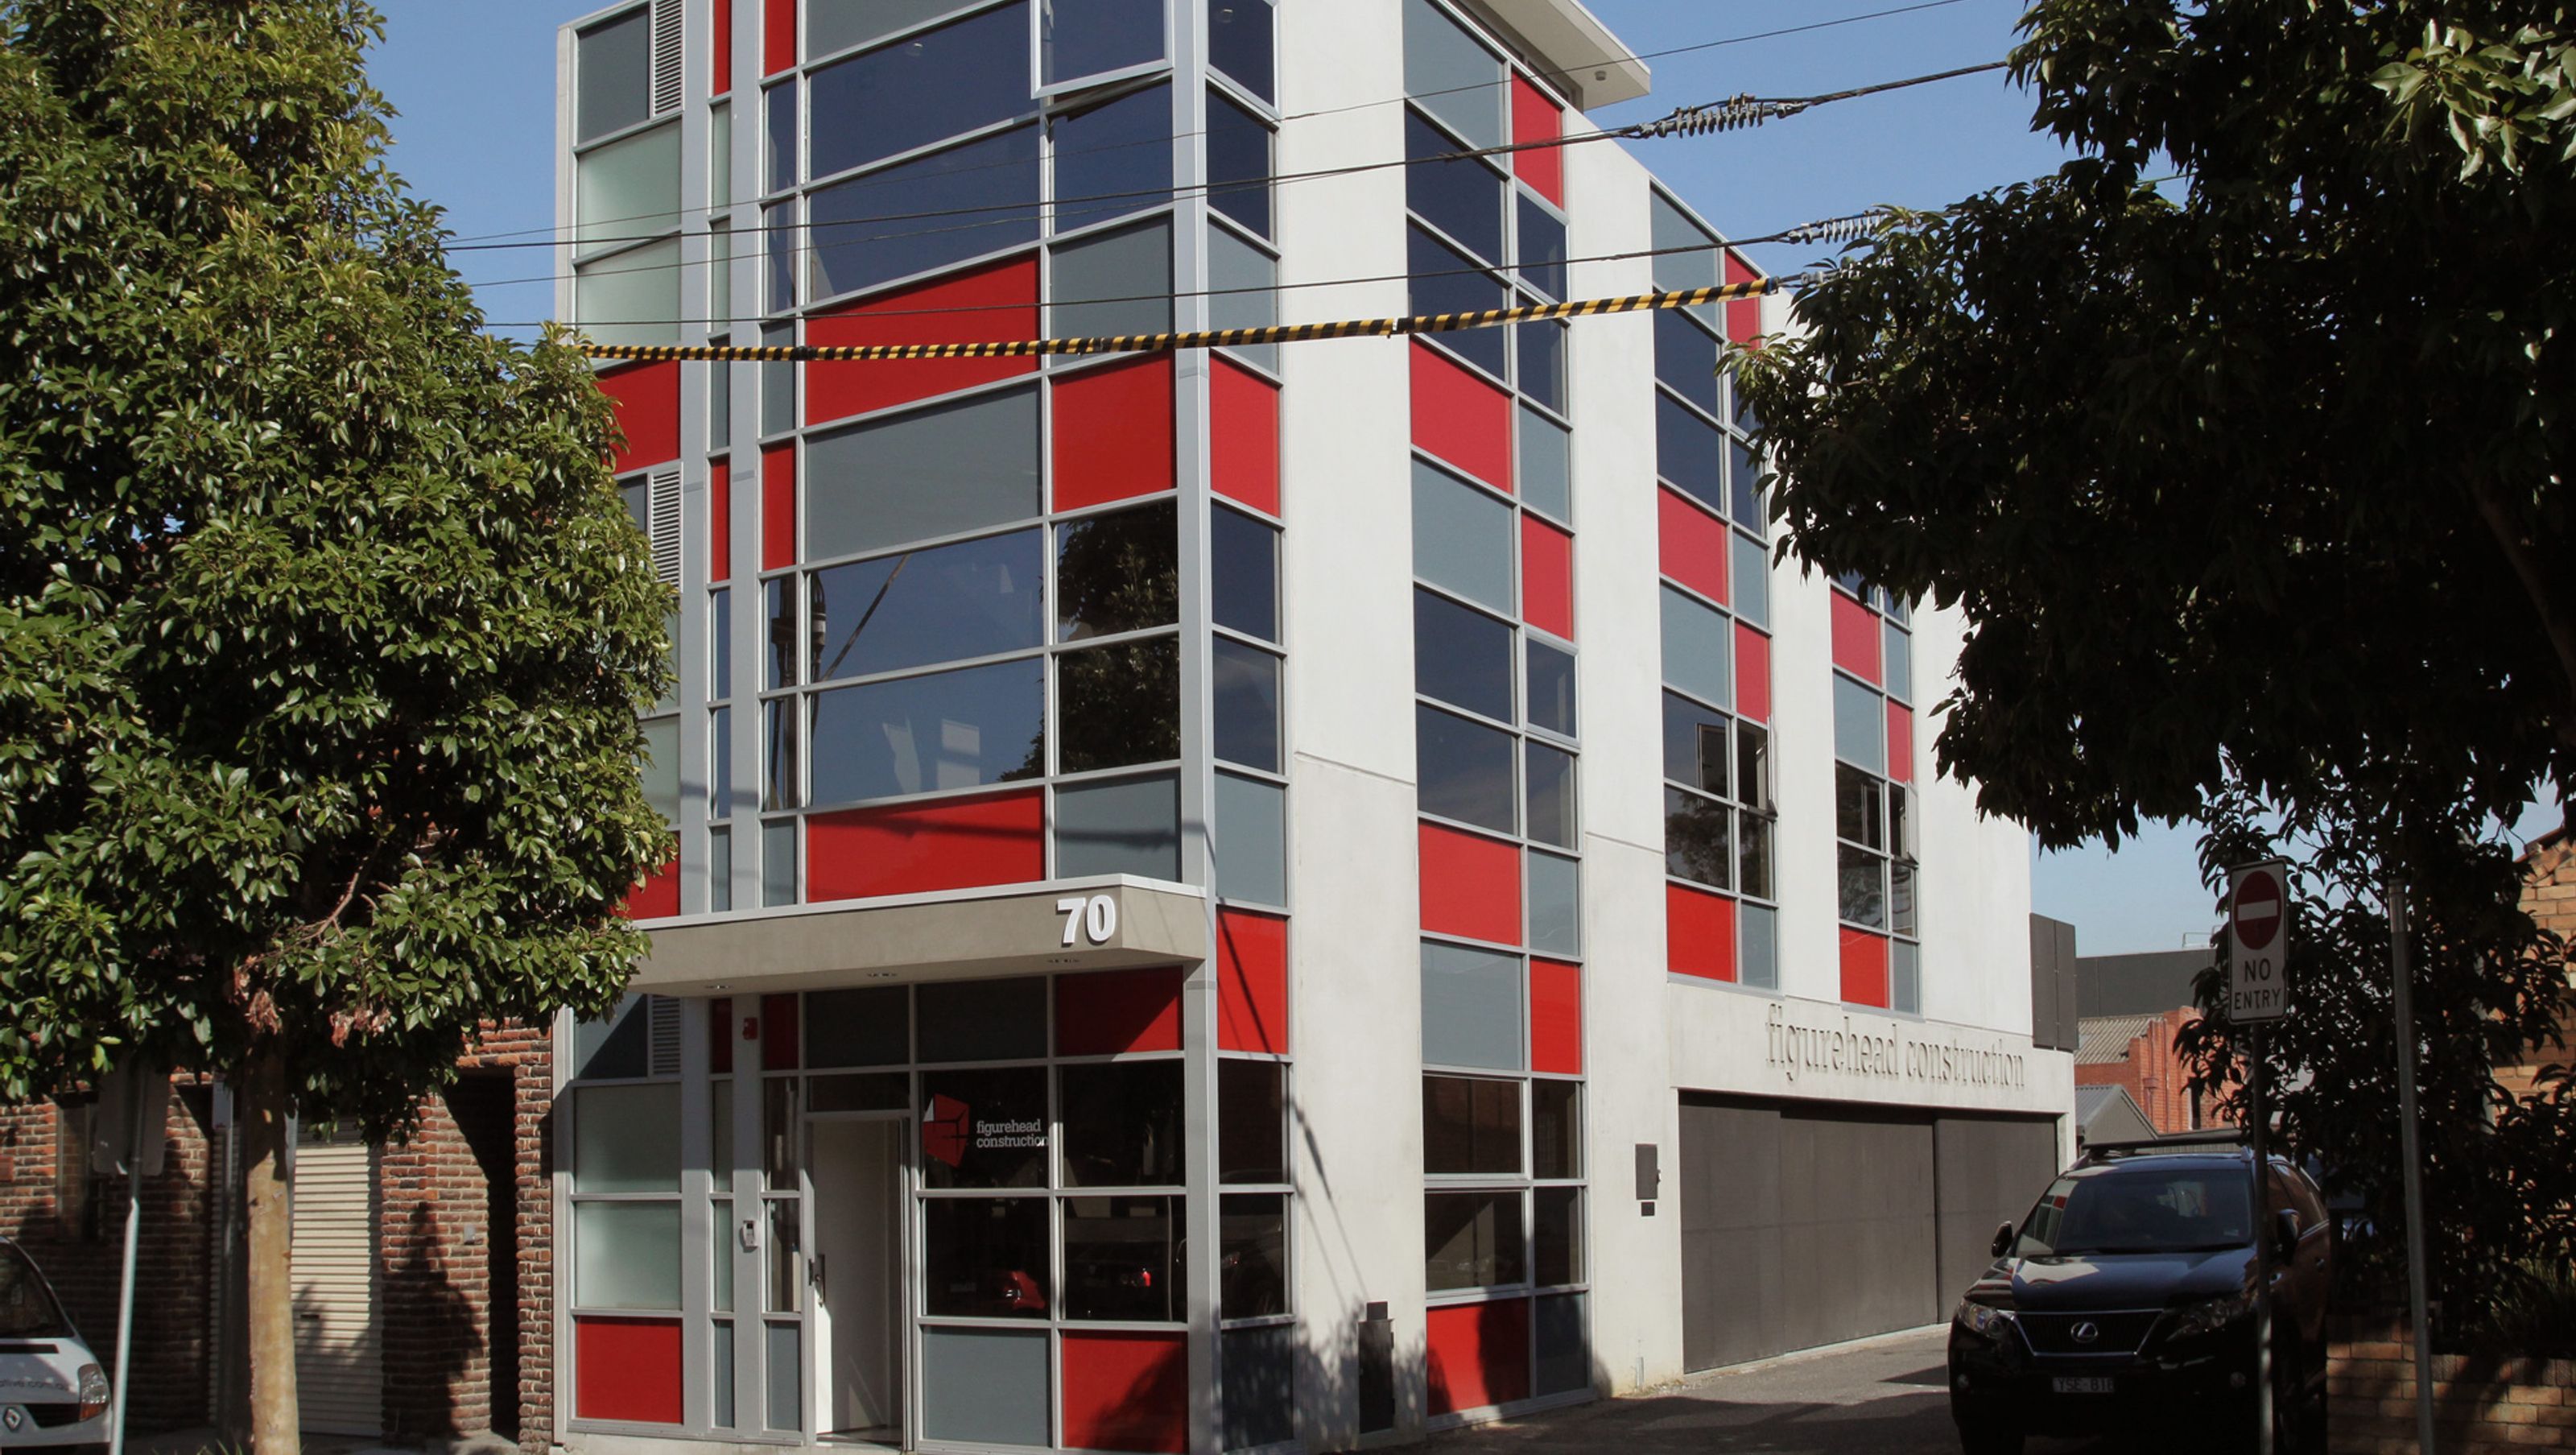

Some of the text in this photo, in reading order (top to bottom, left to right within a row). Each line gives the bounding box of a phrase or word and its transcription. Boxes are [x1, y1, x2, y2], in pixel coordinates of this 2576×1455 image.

[1056, 895, 1116, 945] 70
[2244, 957, 2271, 982] NO
[2234, 987, 2281, 1011] ENTRY
[1765, 1003, 2025, 1089] figurehead construction
[976, 1118, 1042, 1136] figurehead
[976, 1133, 1049, 1148] construction
